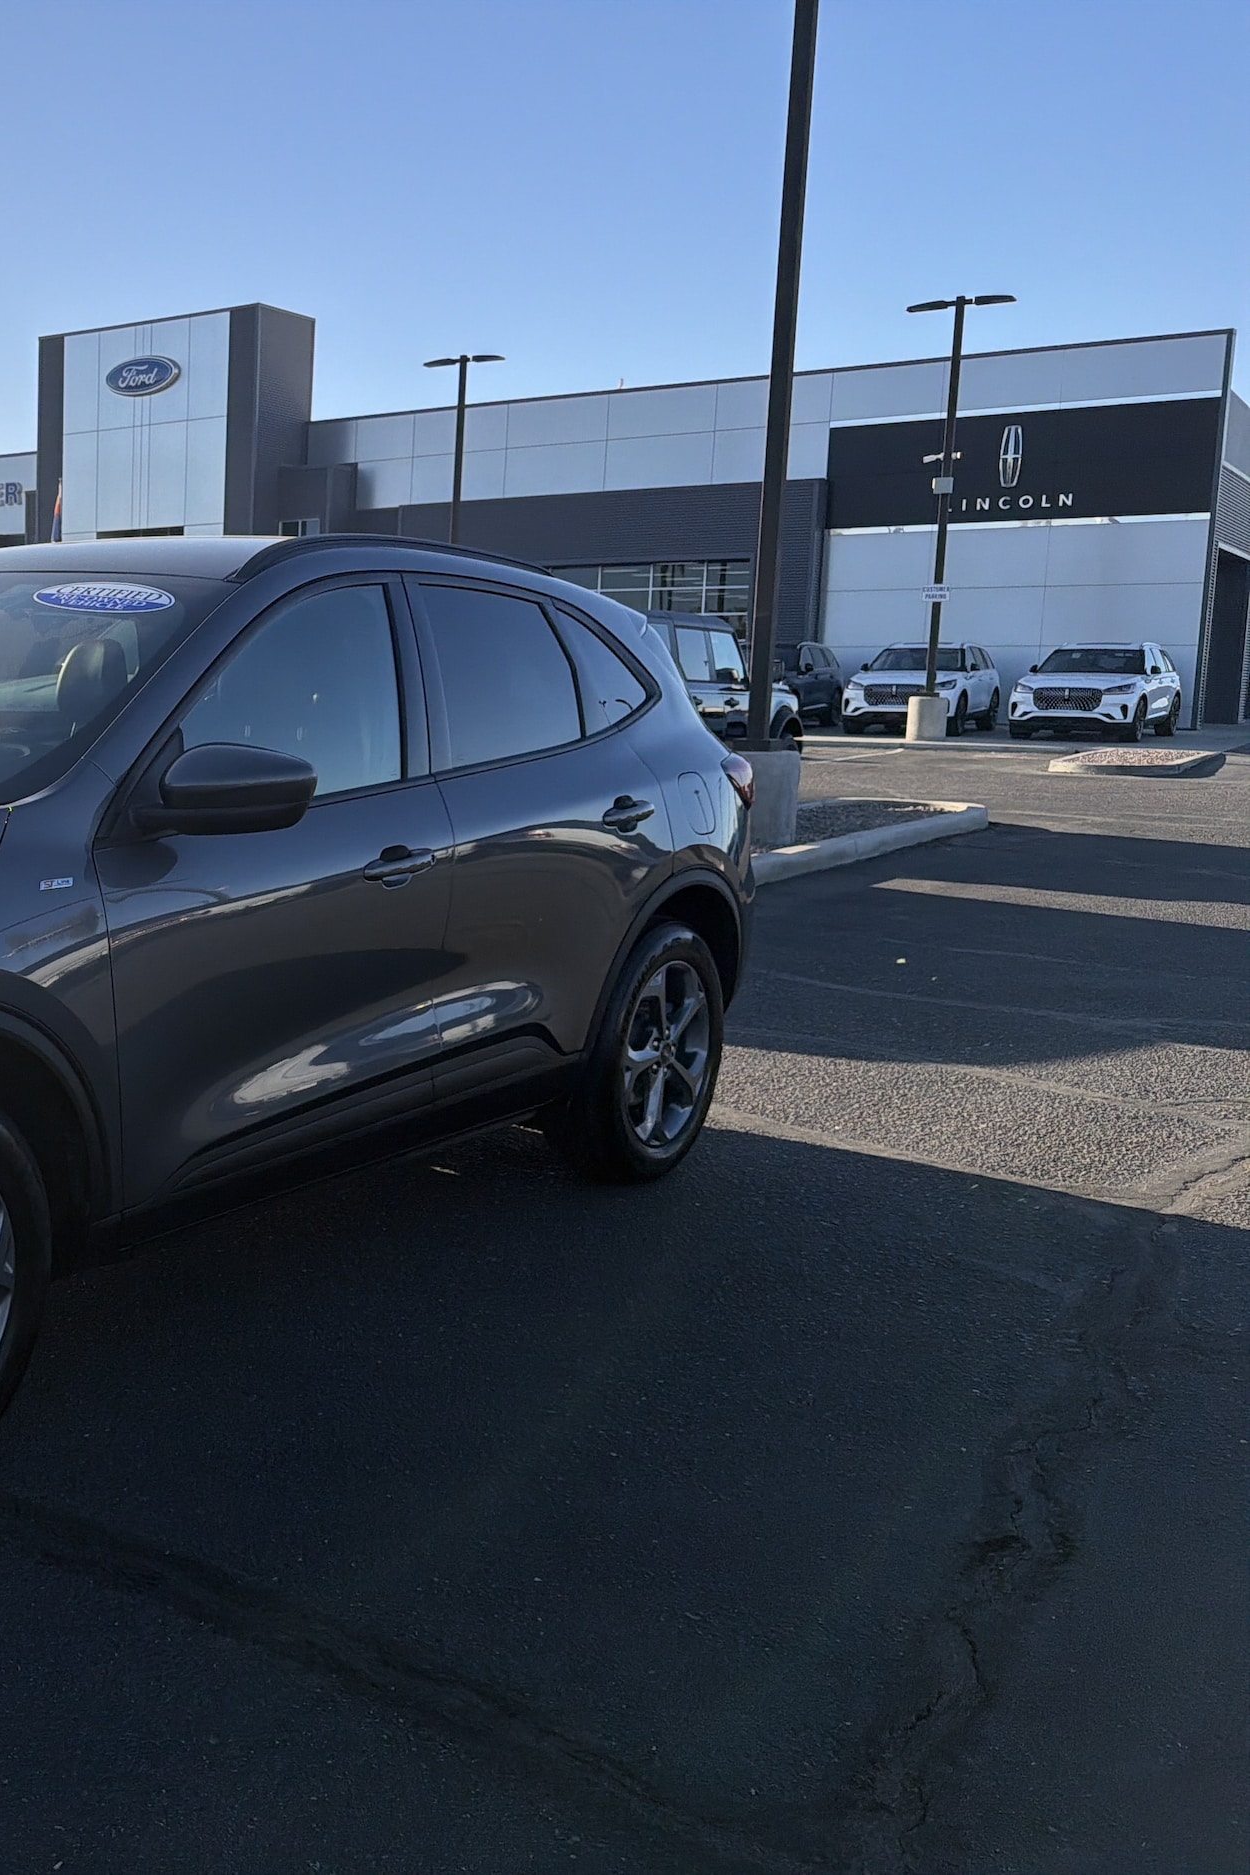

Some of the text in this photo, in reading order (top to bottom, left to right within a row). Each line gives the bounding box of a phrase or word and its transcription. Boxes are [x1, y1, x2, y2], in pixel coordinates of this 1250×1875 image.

[118, 364, 158, 388] Ford
[948, 493, 1073, 512] INCOLN
[51, 593, 147, 607] PRE-OWNED
[56, 586, 163, 601] CERTIFIED
[59, 599, 127, 610] VEHICLE
